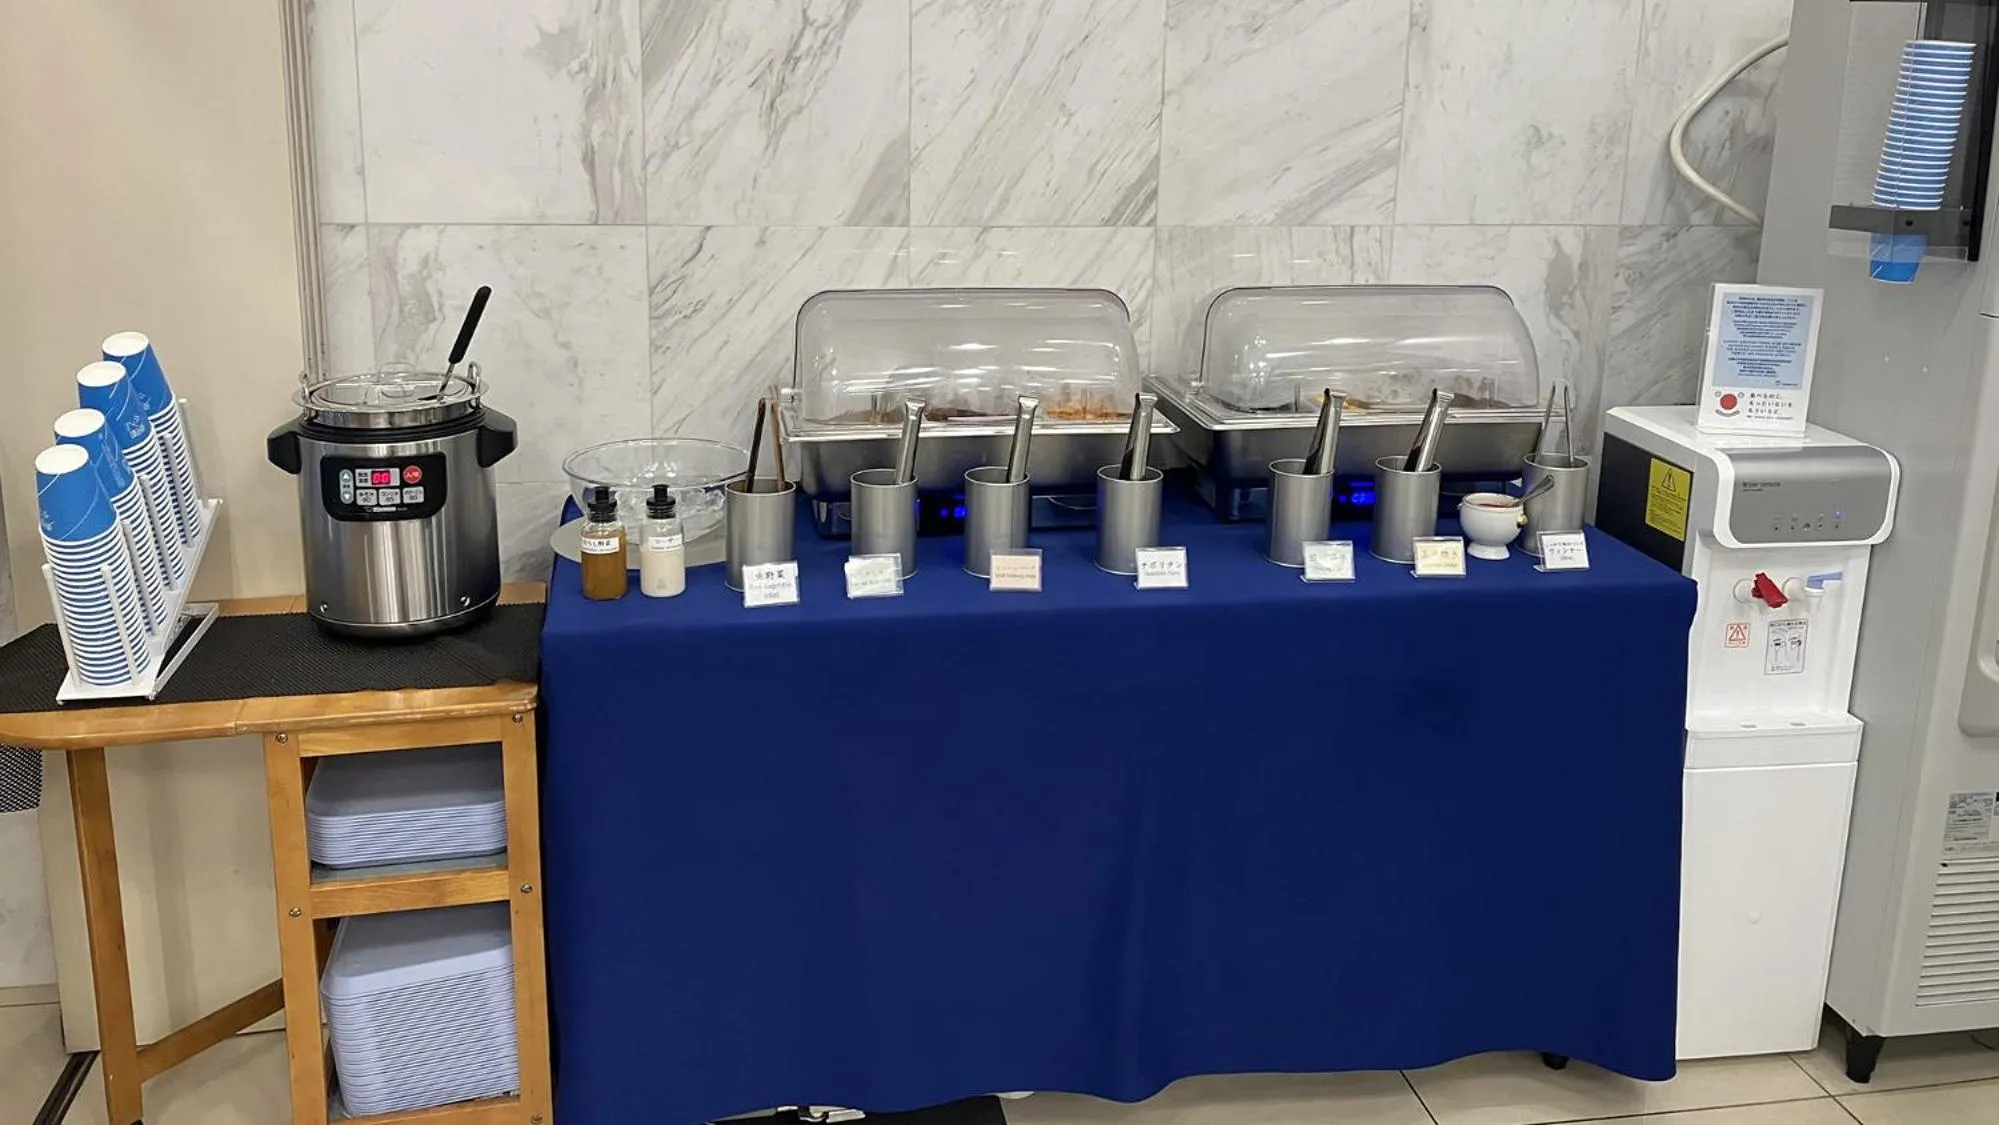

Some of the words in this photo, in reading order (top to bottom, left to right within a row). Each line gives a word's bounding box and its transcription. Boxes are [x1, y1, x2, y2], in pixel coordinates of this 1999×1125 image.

[1142, 560, 1183, 570] ナポリタン
